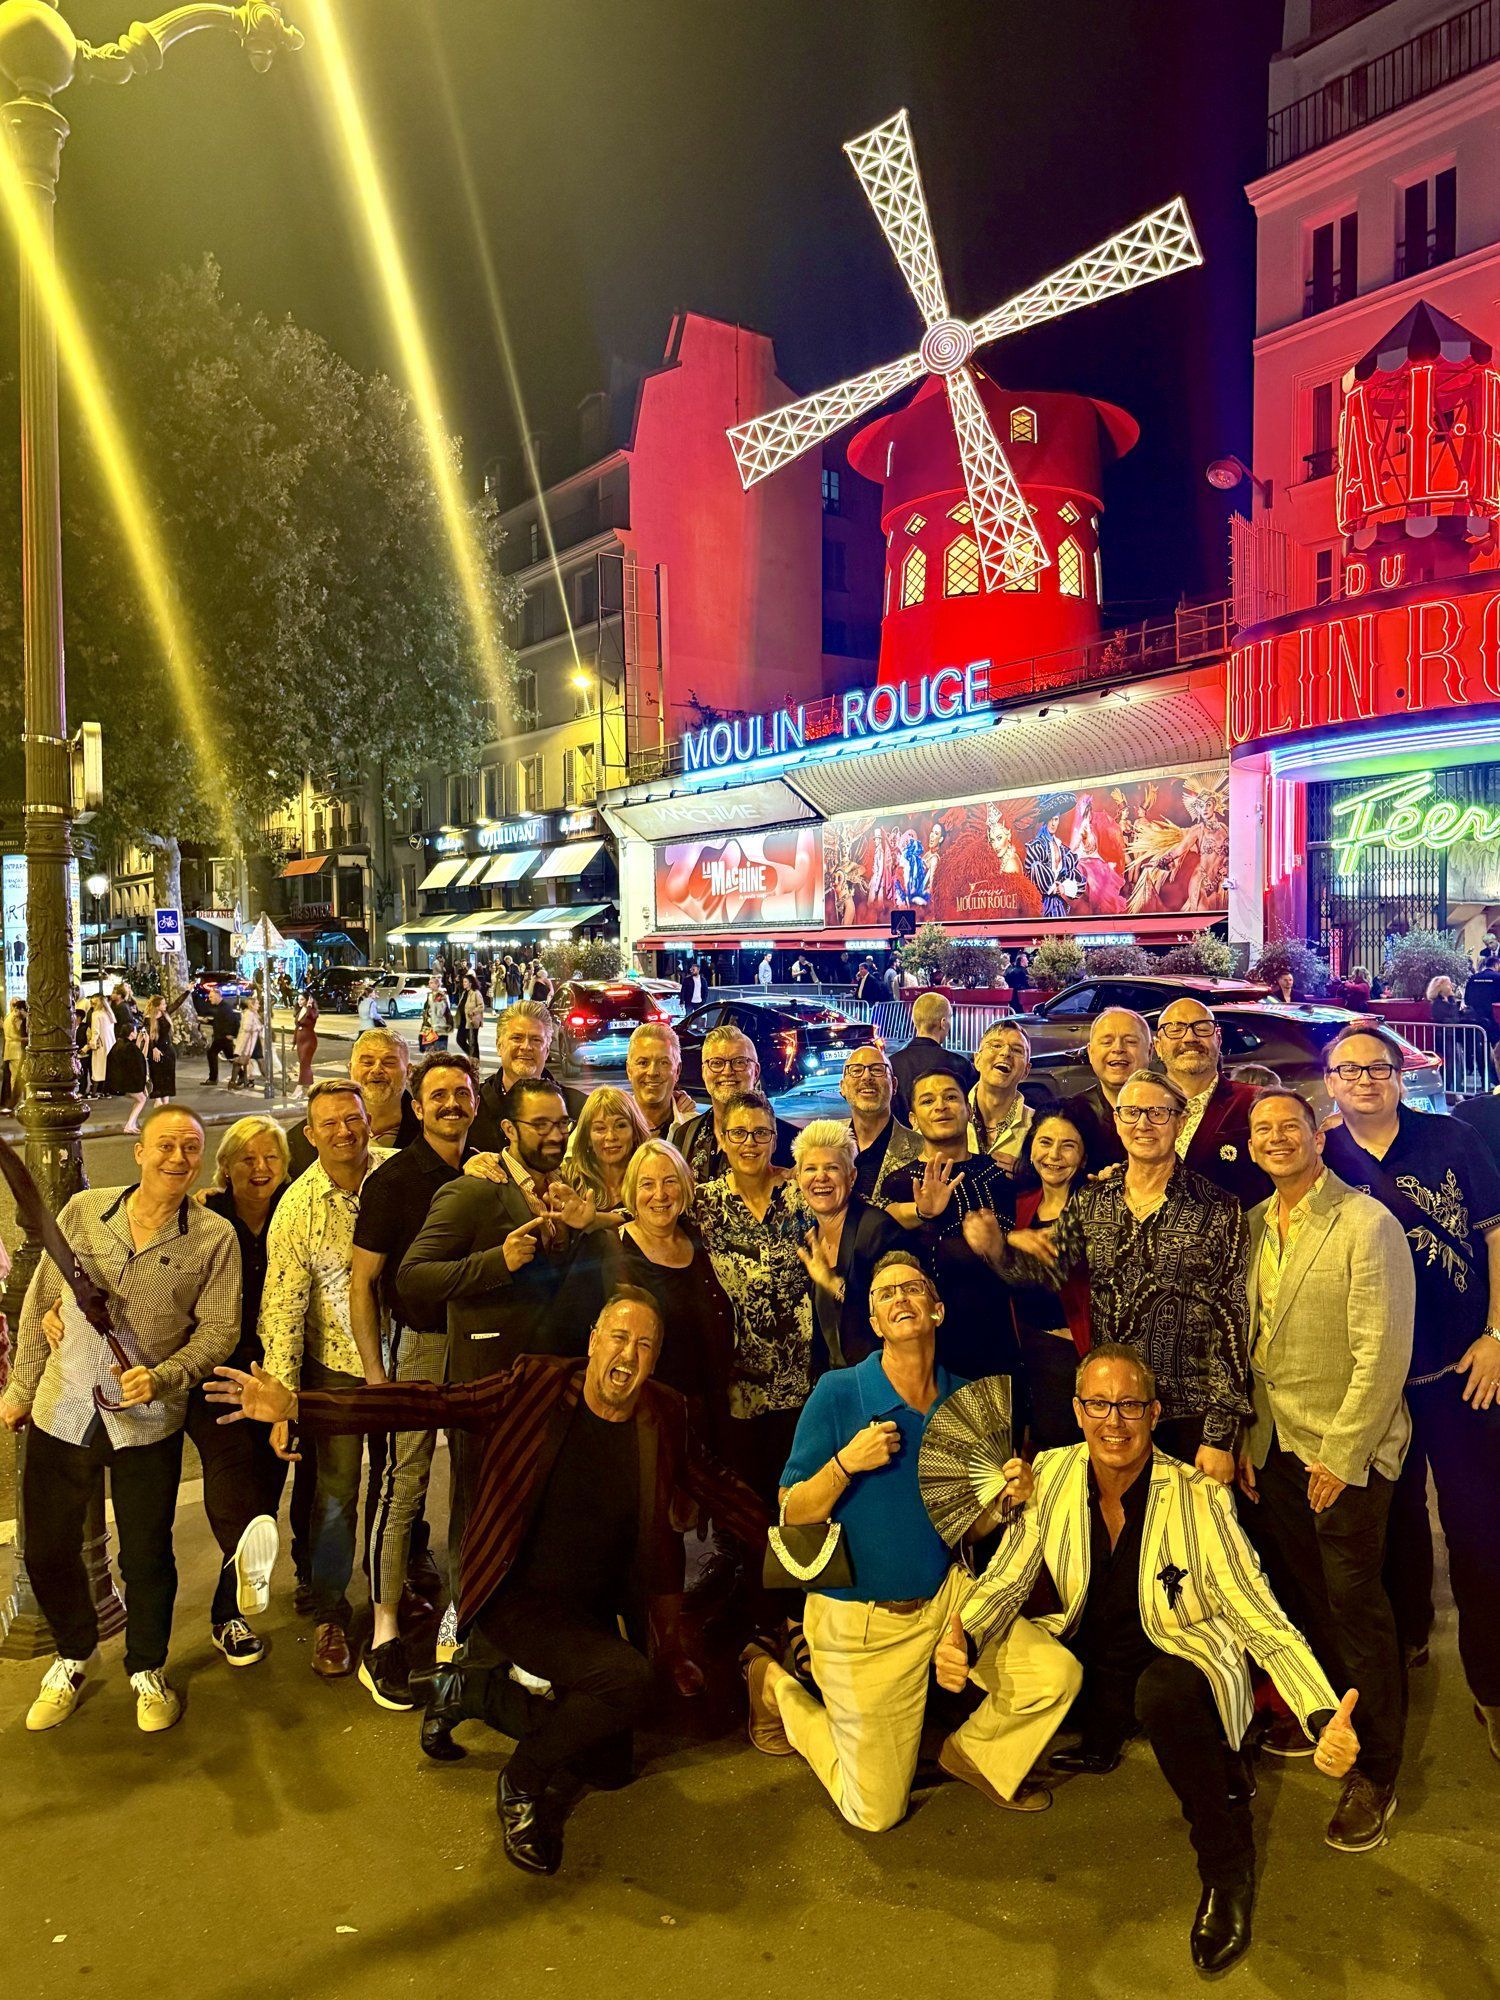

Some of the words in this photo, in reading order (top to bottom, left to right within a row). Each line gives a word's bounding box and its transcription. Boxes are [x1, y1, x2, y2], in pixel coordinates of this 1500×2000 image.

[1336, 366, 1468, 537] AL
[1345, 554, 1404, 597] DU
[1228, 612, 1376, 748] ULIN
[683, 705, 805, 771] MOULIN
[843, 659, 992, 739] ROUGE
[711, 860, 767, 896] MACHINE
[968, 879, 1005, 897] Forever
[200, 910, 215, 918] DEUX
[956, 895, 986, 912] MOULIN
[987, 893, 1018, 910] ROUGE
[346, 920, 364, 929] BAR
[1074, 935, 1104, 947] MOULIN
[1105, 934, 1135, 946] ROUGE
